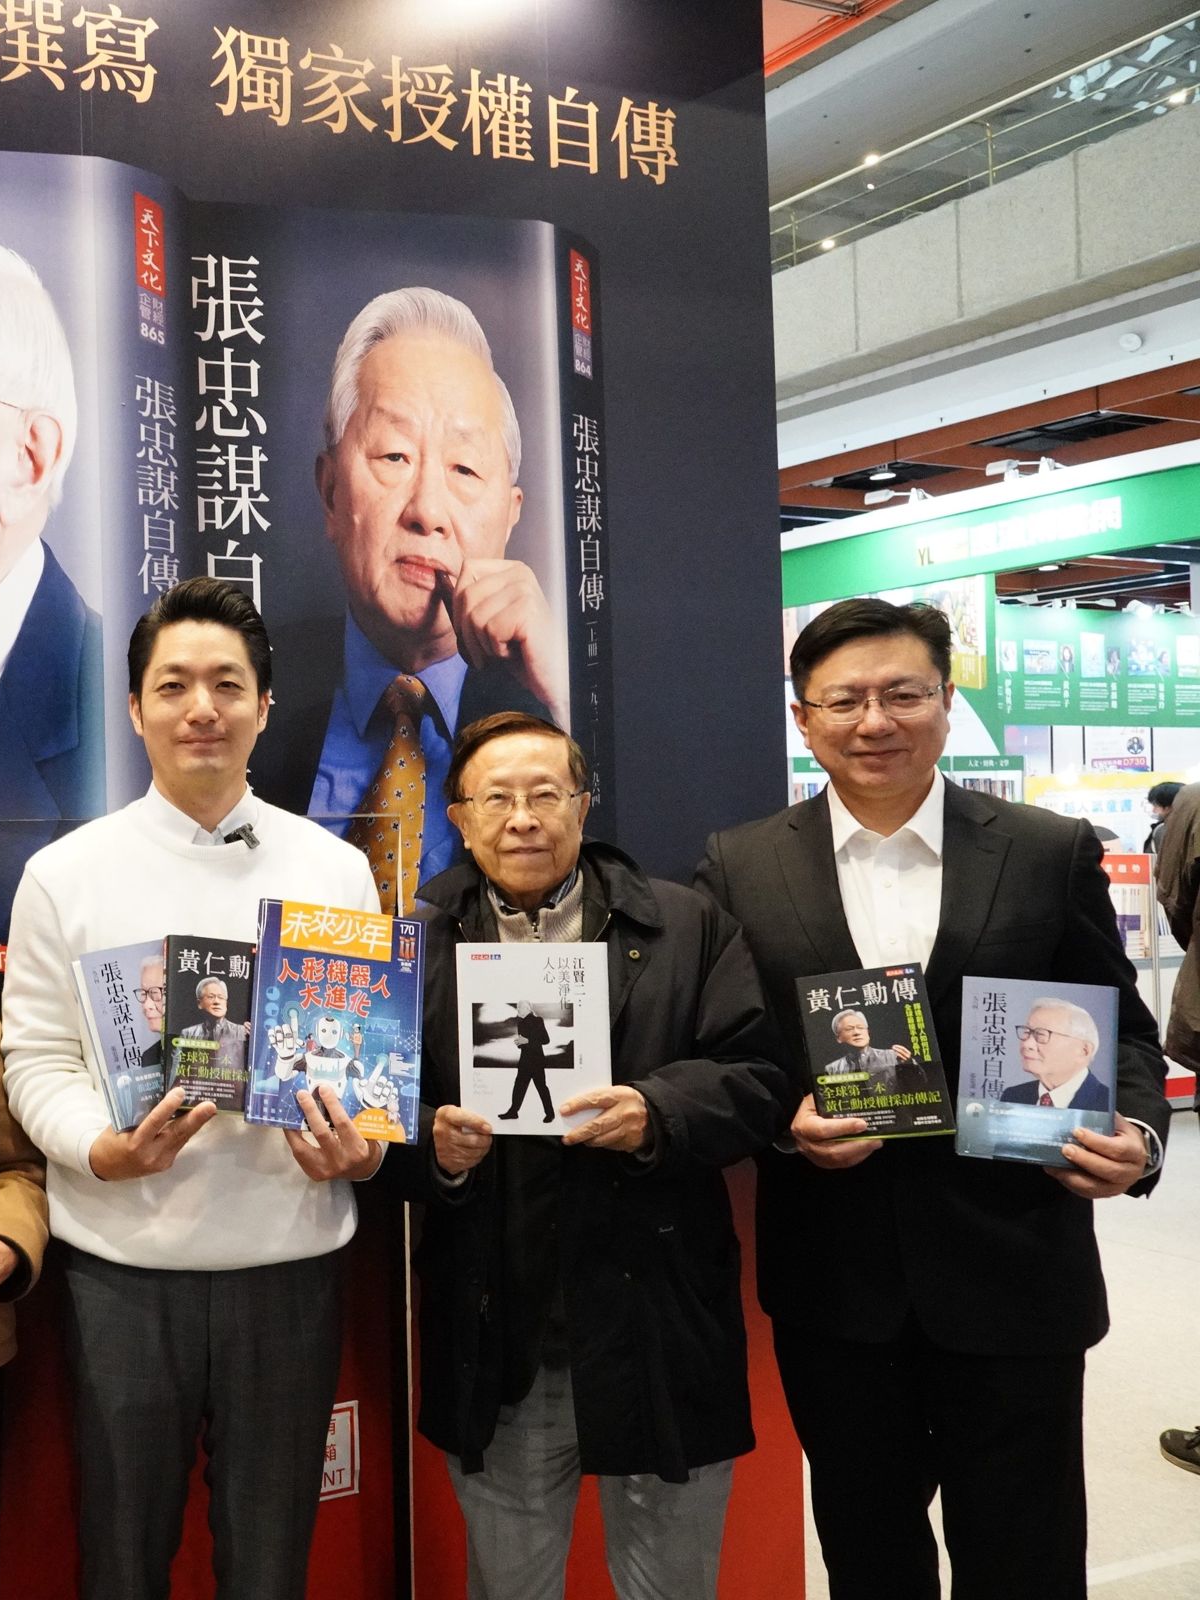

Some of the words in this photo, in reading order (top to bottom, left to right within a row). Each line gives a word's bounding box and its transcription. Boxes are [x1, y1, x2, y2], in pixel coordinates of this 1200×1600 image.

[209, 25, 680, 186] 獨家授權自傳
[140, 207, 163, 292] 天下文化
[573, 259, 590, 330] 天下文化
[140, 321, 166, 345] 865
[574, 359, 592, 377] 864
[190, 253, 272, 616] 張忠謀自
[134, 373, 181, 596] 張忠謀自傳
[571, 413, 605, 613] 張忠謀自傳
[280, 906, 392, 954] 未來少年
[399, 924, 415, 936] 170
[177, 949, 251, 980] 黃仁勳
[277, 956, 393, 999] 人形機器人
[543, 956, 556, 984] 人心
[557, 956, 571, 1010] 以美淨化
[100, 960, 143, 1070] 張忠謀自傳
[299, 984, 372, 1018] 大進化
[806, 977, 918, 1014] 黃仁勳傳
[177, 1050, 233, 1067] 全球第一本
[981, 991, 1008, 1101] 張忠謀自傳
[822, 1082, 887, 1099] 全球第一本
